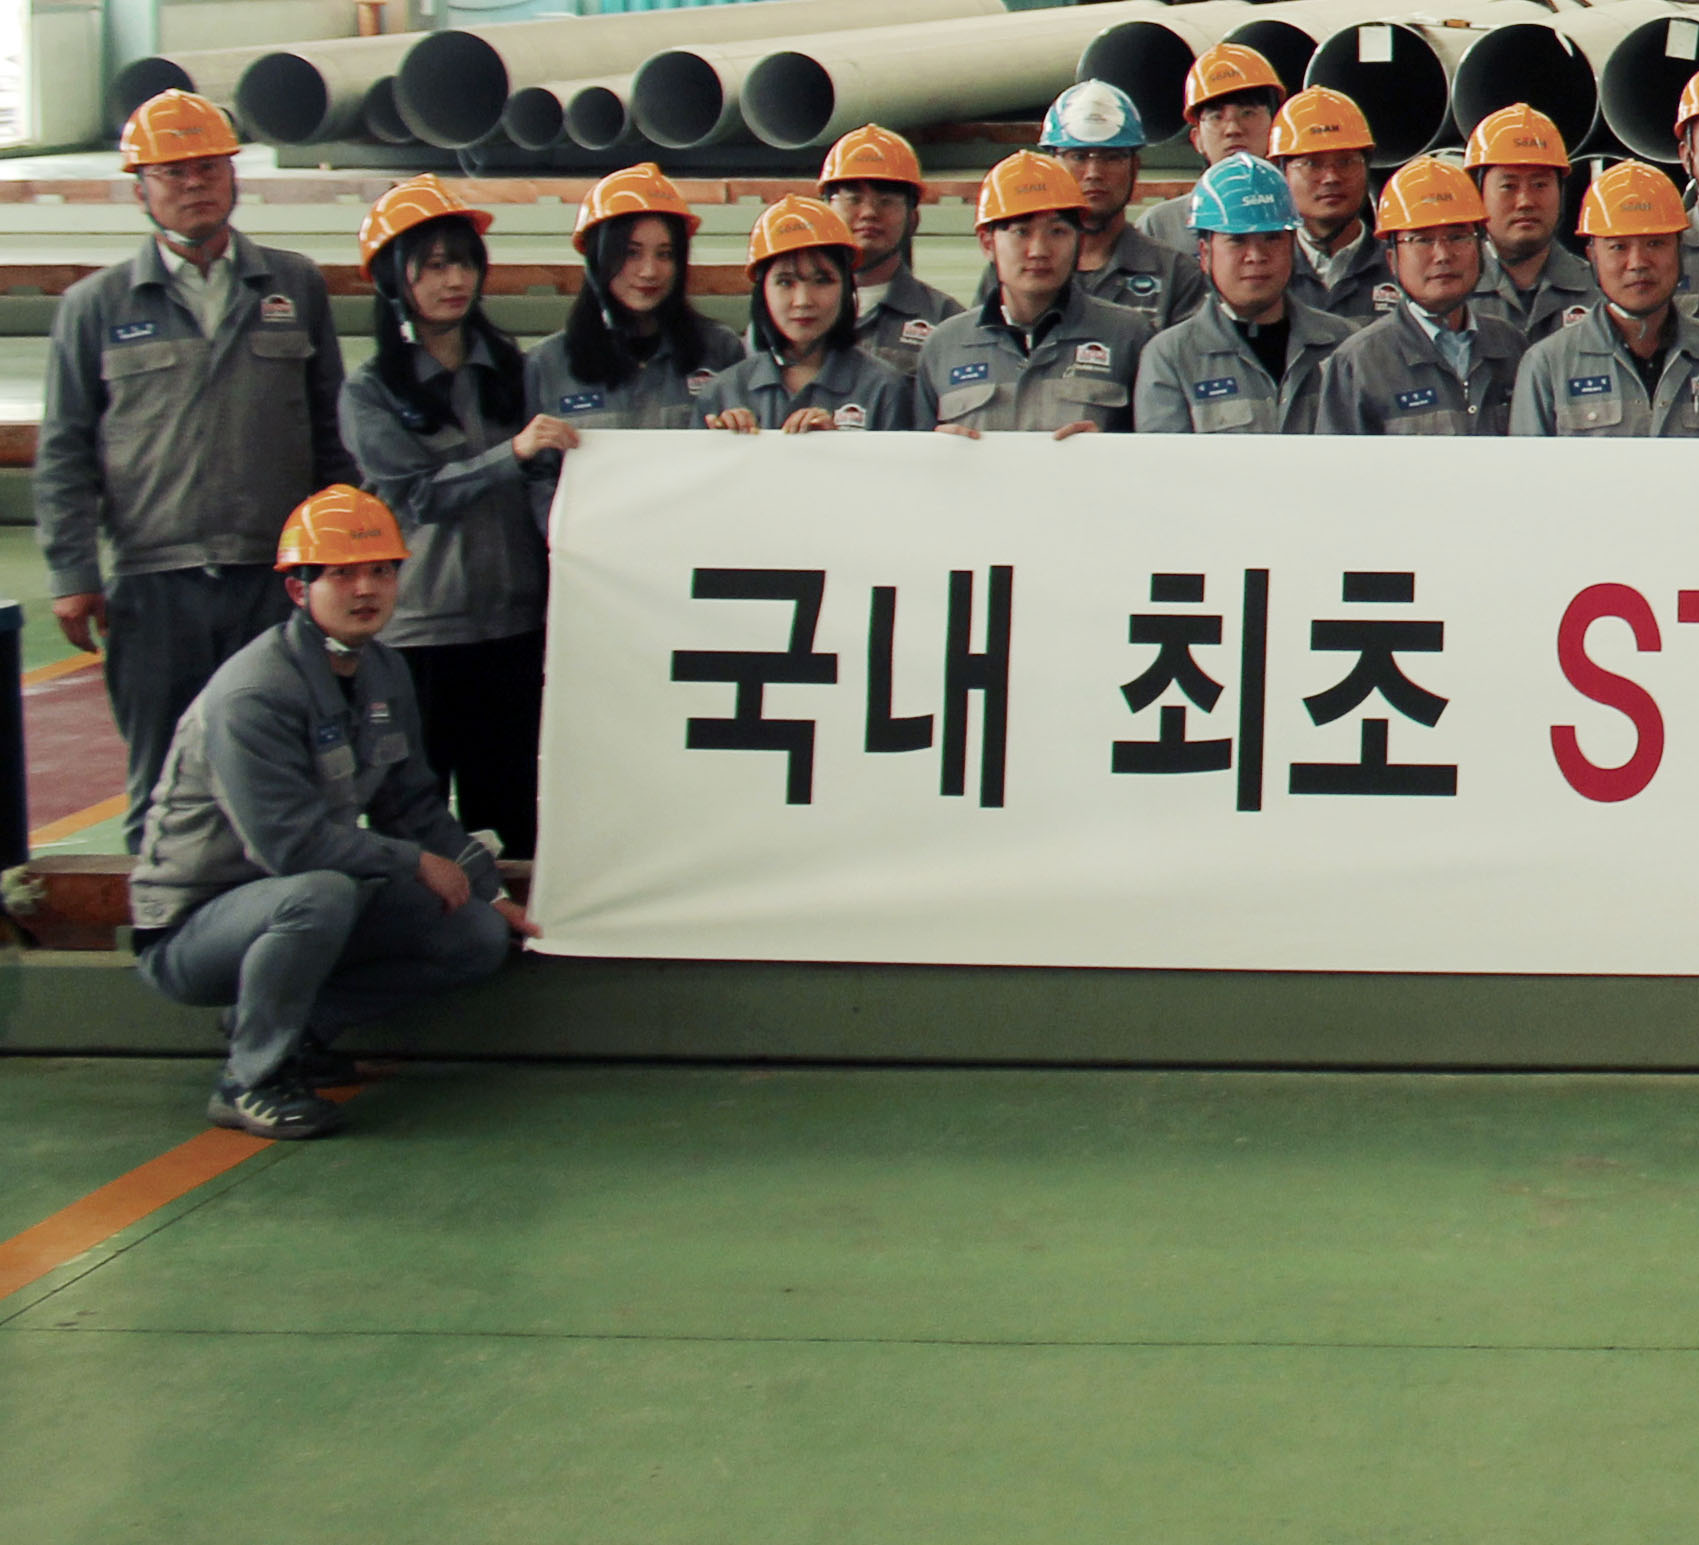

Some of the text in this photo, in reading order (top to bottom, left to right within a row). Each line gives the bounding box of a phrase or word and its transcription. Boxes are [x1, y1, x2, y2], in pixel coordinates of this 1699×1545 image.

[1242, 191, 1275, 206] SeAH
[672, 566, 1013, 808] 국내
[1112, 569, 1458, 812] 최초
